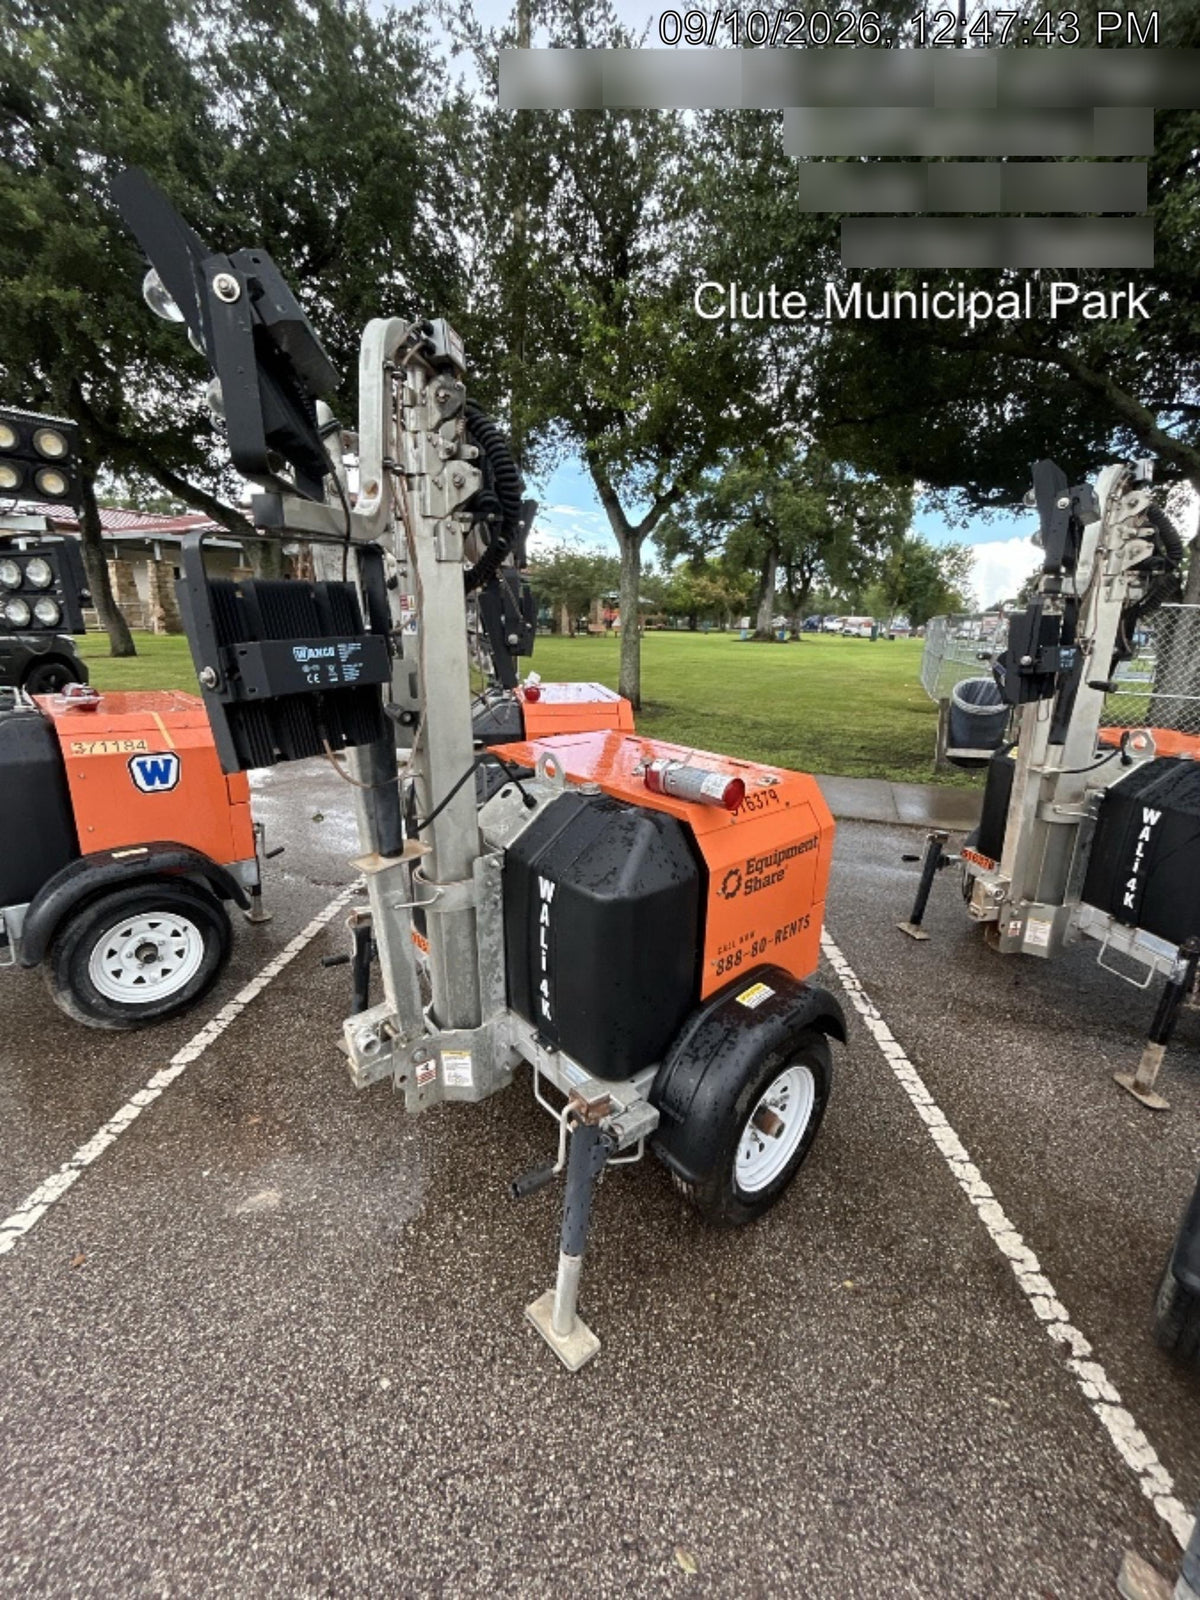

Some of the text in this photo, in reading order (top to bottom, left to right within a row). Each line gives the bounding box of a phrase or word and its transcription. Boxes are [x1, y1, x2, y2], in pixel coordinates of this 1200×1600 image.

[136, 759, 173, 787] W
[746, 835, 819, 876] Equipment
[743, 868, 785, 896] Share
